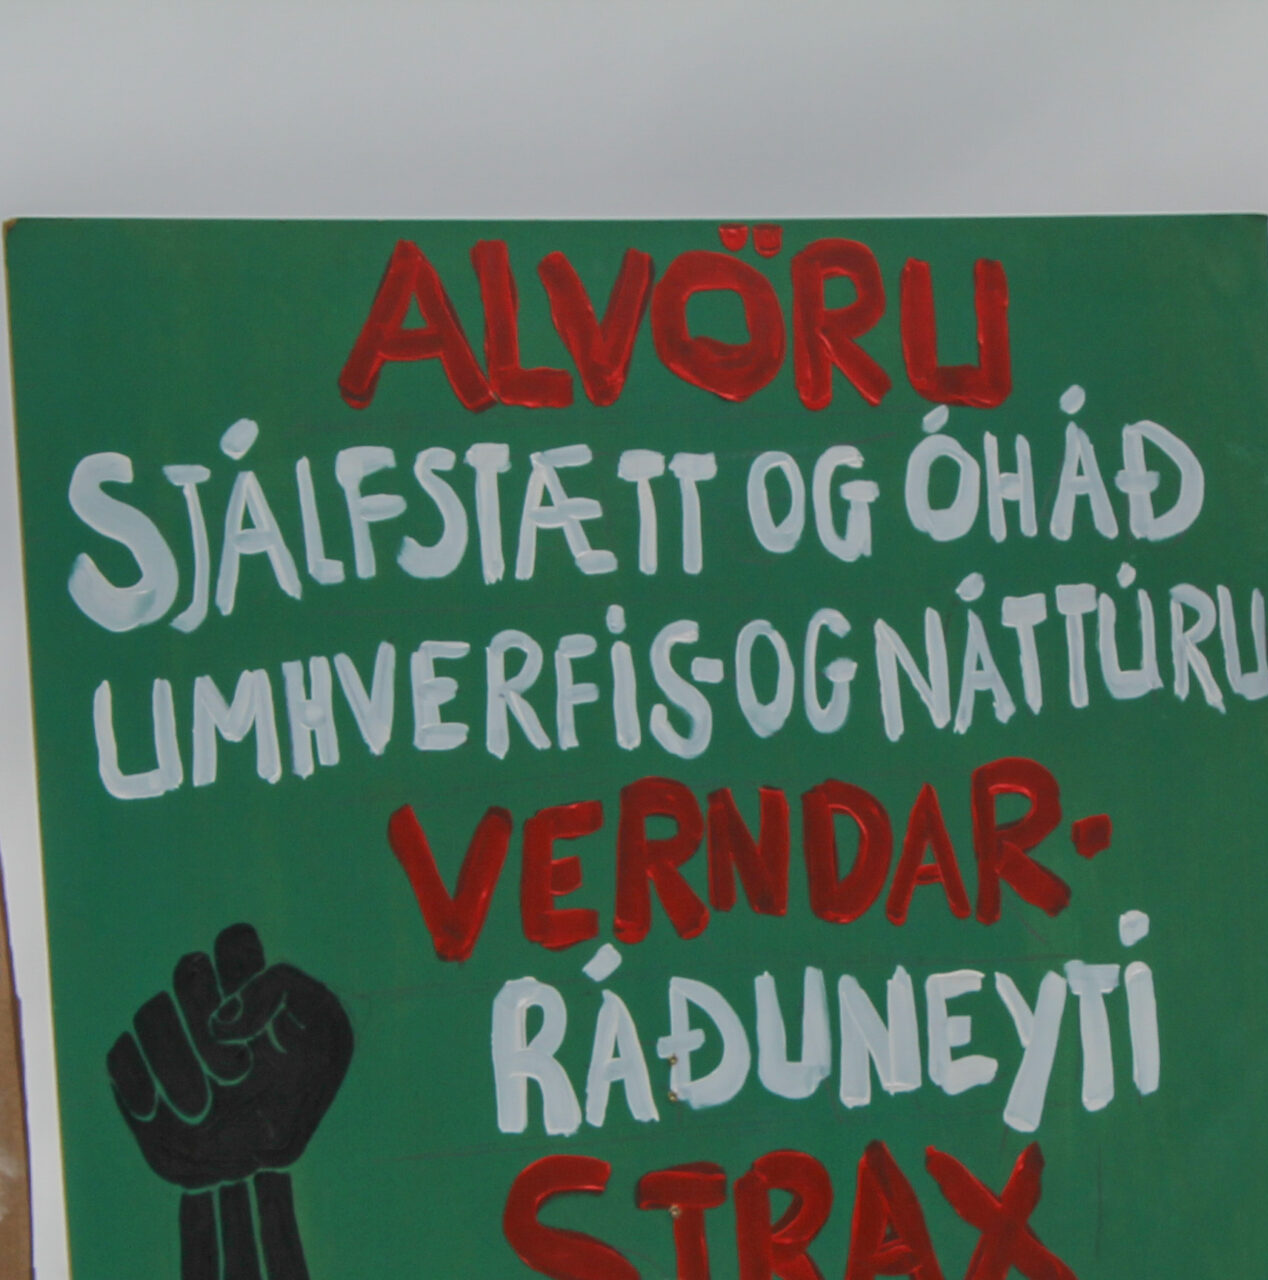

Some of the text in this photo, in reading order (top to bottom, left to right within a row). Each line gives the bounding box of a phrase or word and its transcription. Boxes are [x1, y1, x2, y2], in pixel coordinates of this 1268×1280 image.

[338, 223, 1013, 413] ALVÖRU
[67, 384, 1205, 633] SJÁLFSTÆTT OG ÓHÁÐ
[735, 607, 858, 739] OG
